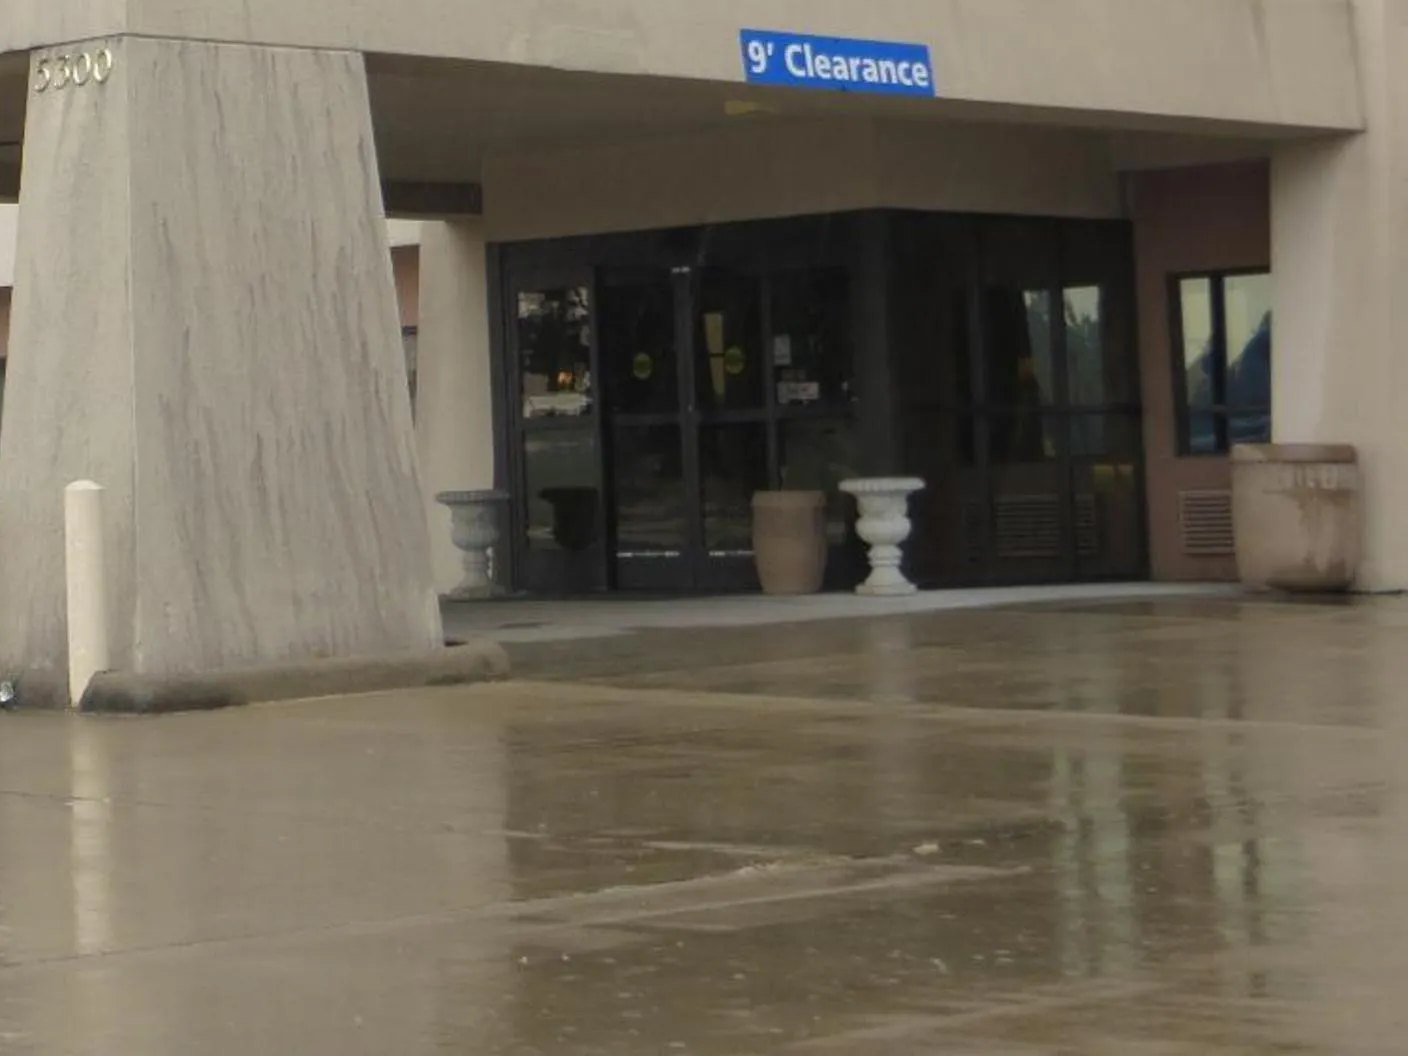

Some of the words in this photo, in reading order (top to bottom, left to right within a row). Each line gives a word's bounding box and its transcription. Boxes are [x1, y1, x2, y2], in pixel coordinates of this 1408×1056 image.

[33, 47, 112, 93] 5300
[748, 40, 774, 74] 9'
[784, 43, 930, 87] Clearance
